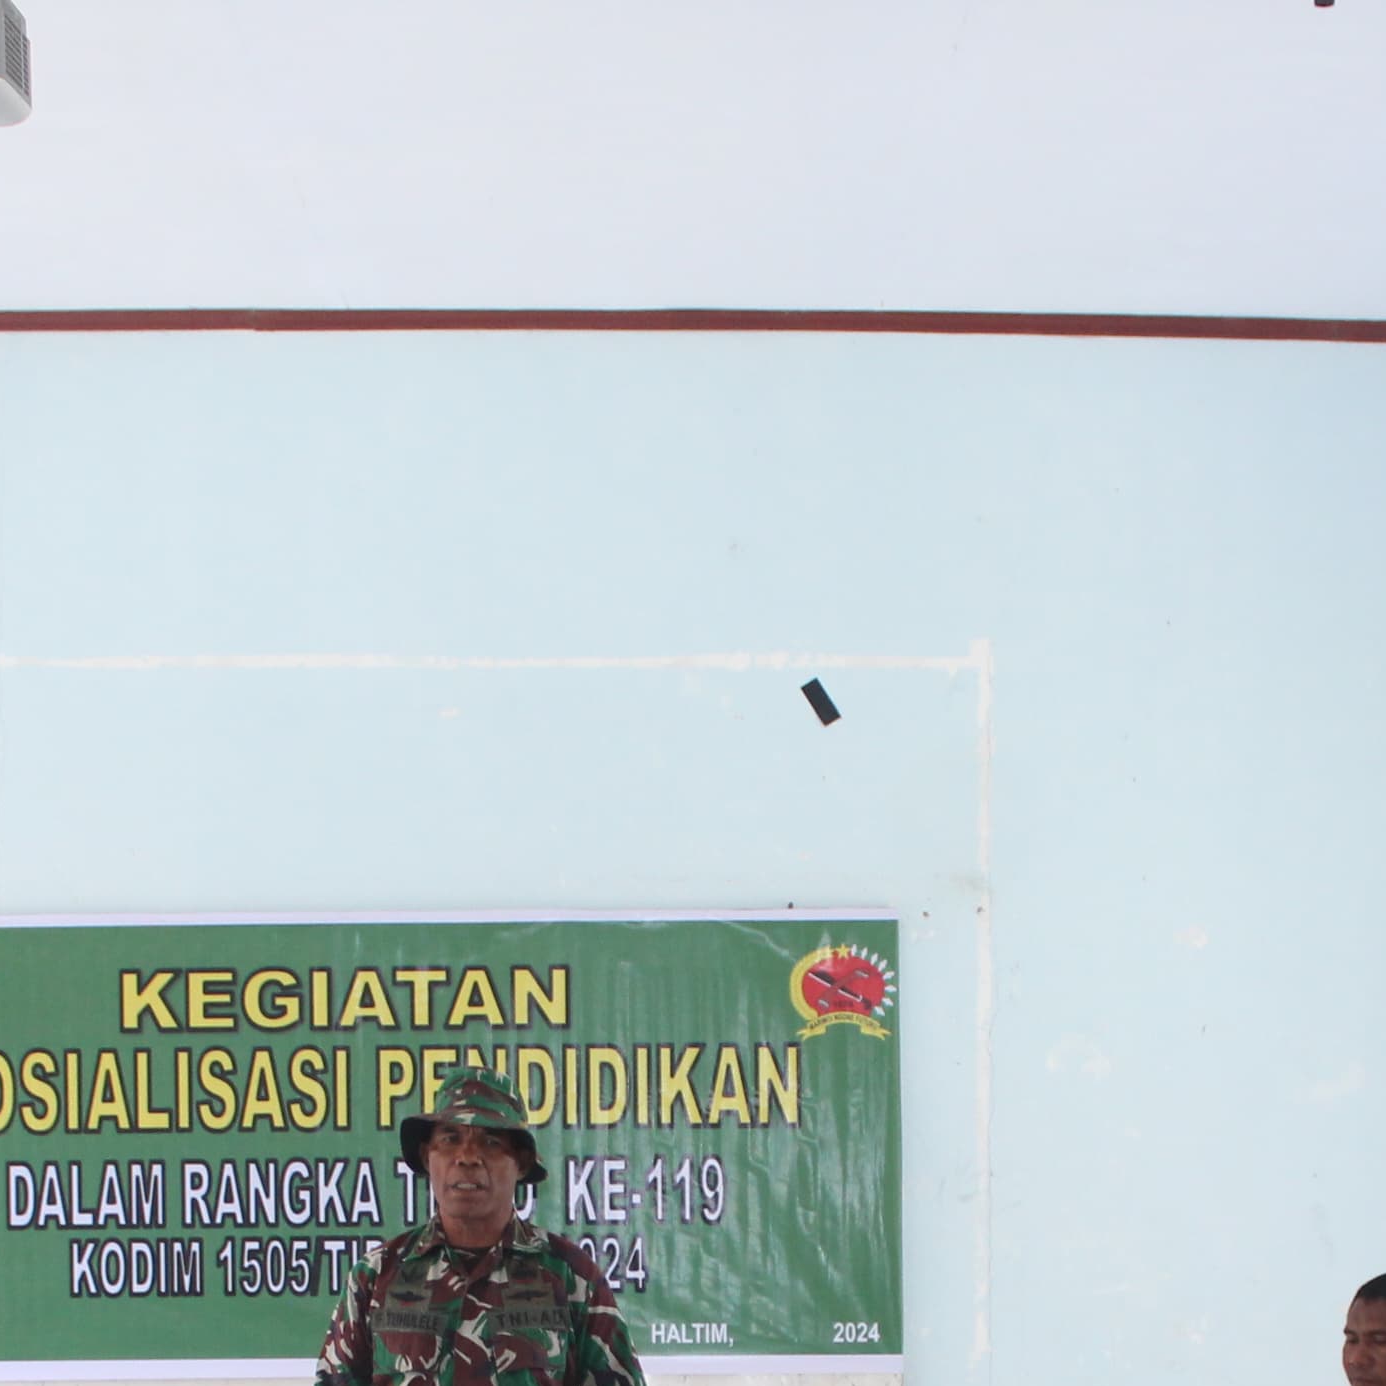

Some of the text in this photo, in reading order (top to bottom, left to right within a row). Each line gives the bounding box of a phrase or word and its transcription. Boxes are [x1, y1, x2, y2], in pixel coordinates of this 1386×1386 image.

[120, 966, 570, 1032] KEGIATAN
[376, 1043, 801, 1130] PEDIDIKAN
[7, 1160, 165, 1229] DALAM
[180, 1158, 383, 1228] RANGKA
[566, 1155, 726, 1225] KE-119
[69, 1238, 204, 1297] KODIM
[651, 1322, 881, 1347] HALTIM, 2024
